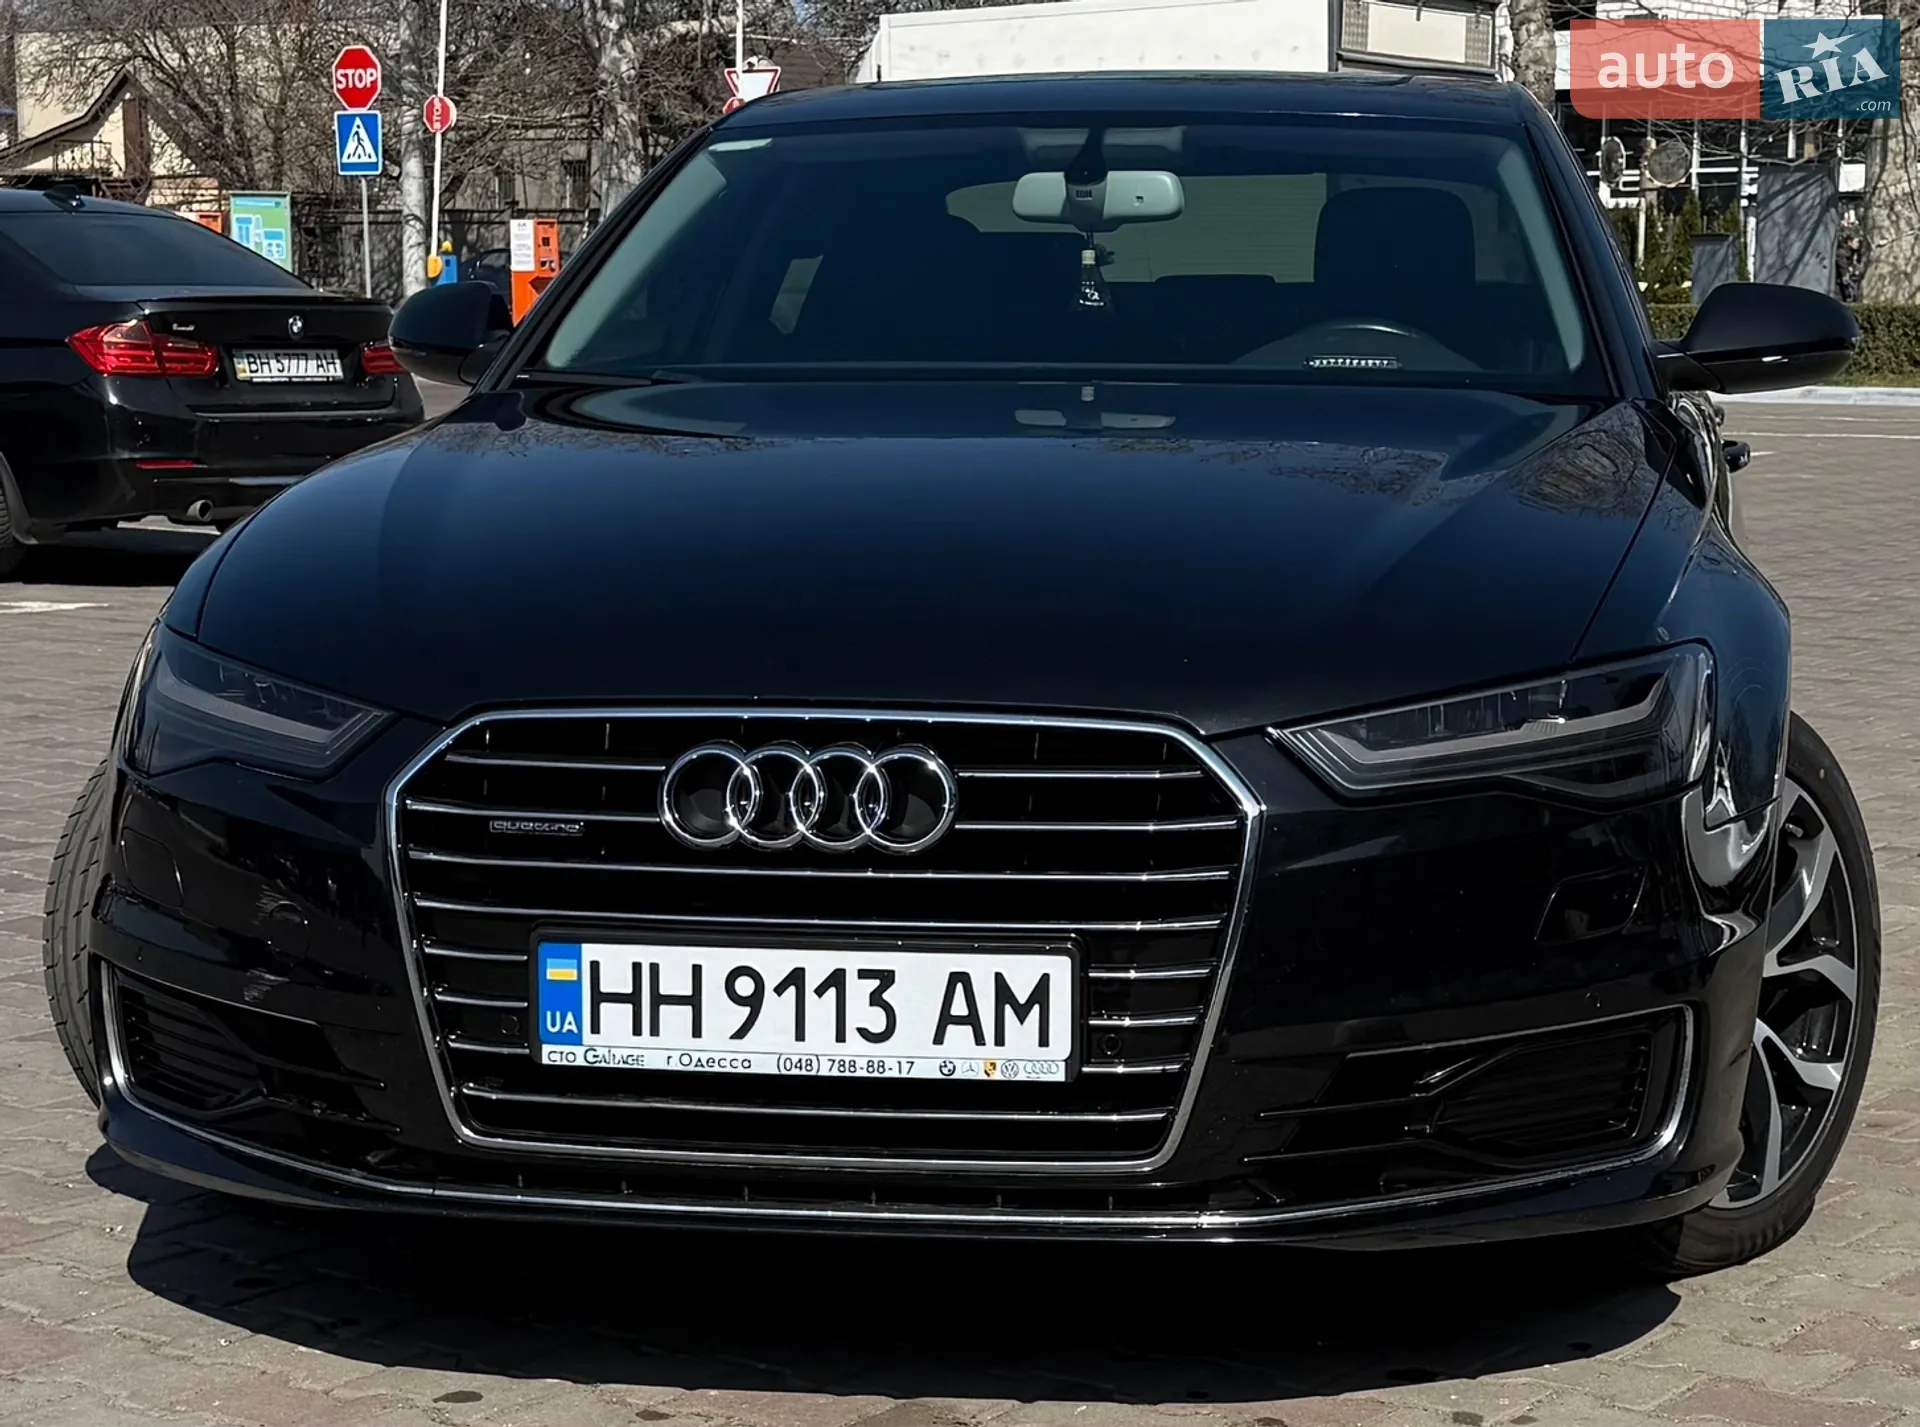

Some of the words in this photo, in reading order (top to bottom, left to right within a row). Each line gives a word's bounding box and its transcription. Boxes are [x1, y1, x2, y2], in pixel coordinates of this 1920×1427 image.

[336, 67, 378, 89] STOP
[245, 352, 271, 374] BH
[315, 352, 338, 374] AH
[589, 959, 703, 1039] HH
[724, 964, 897, 1044] 9113
[932, 971, 1051, 1048] AM
[546, 1010, 578, 1034] UA
[776, 1053, 821, 1075] (048)
[827, 1058, 915, 1076] 788-88-17
